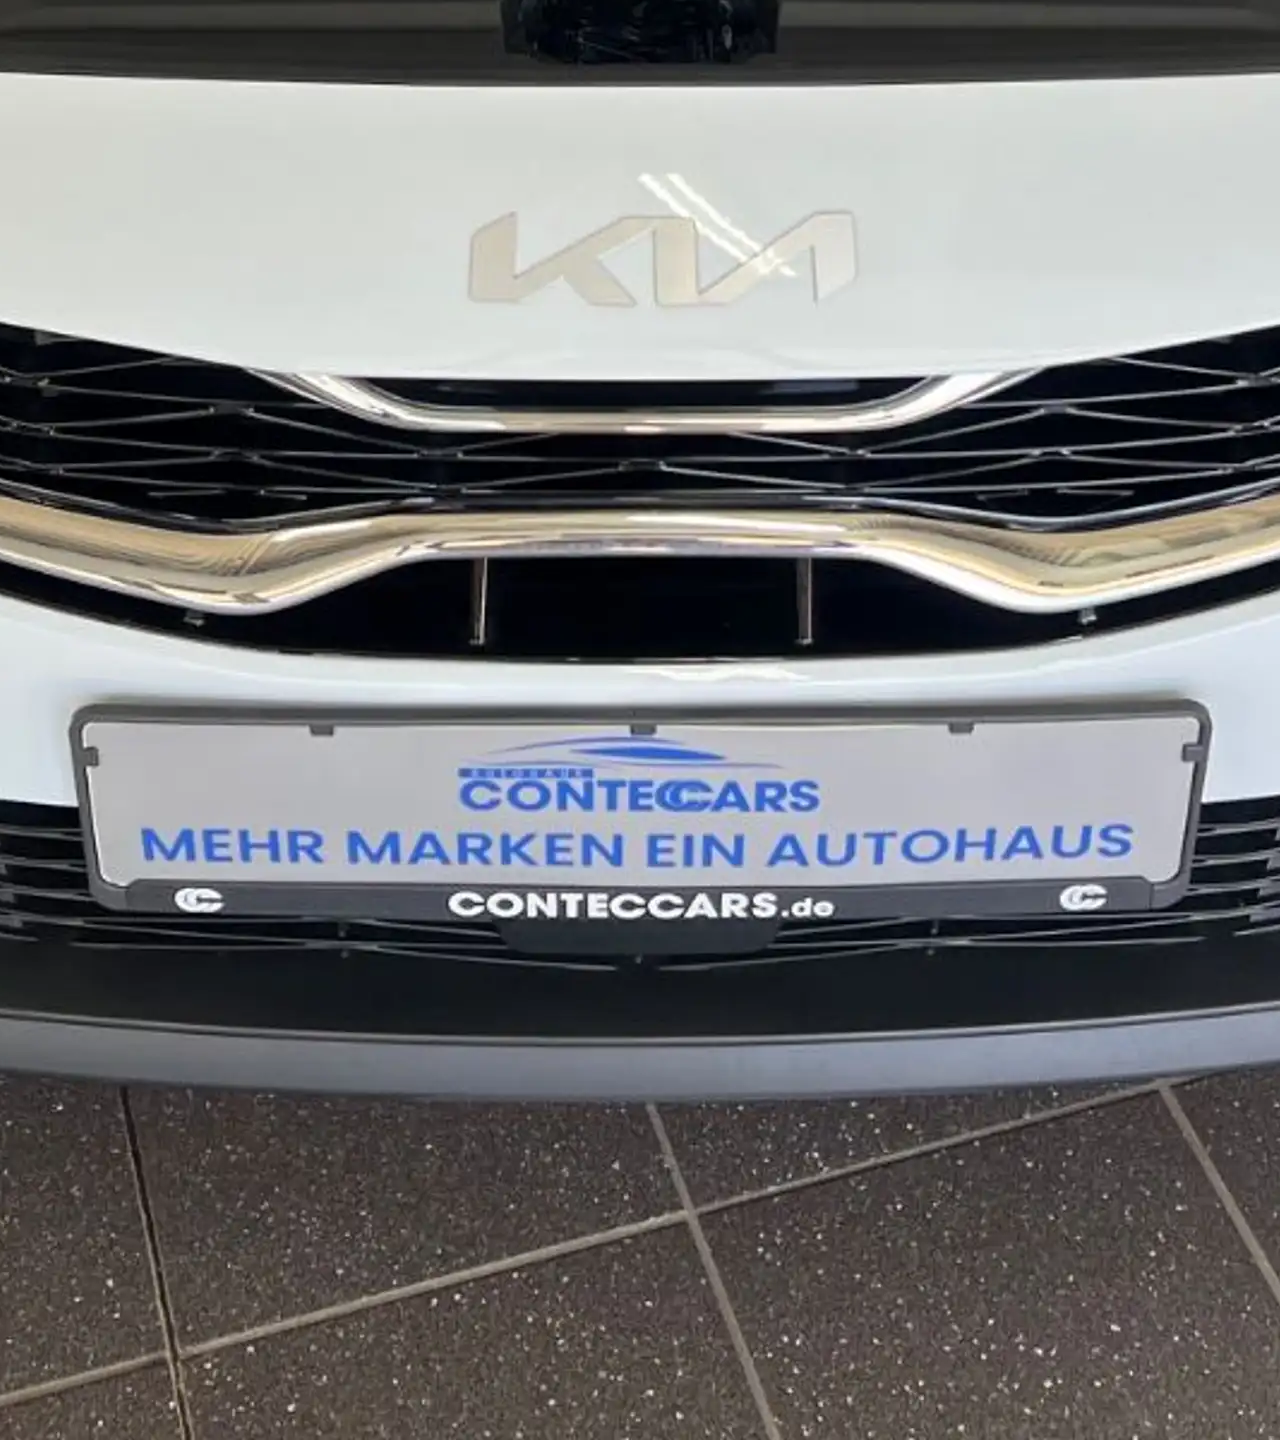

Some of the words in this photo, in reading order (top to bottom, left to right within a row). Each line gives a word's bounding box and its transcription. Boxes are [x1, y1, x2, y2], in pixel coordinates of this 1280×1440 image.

[468, 210, 858, 308] KIA
[459, 779, 821, 813] CONTECCARS
[140, 826, 325, 866] MEHR
[346, 829, 624, 868] MARKEN
[645, 832, 745, 869] EIN
[766, 822, 1134, 868] AUTOHAUS
[446, 890, 836, 919] CONTECCARS.de
